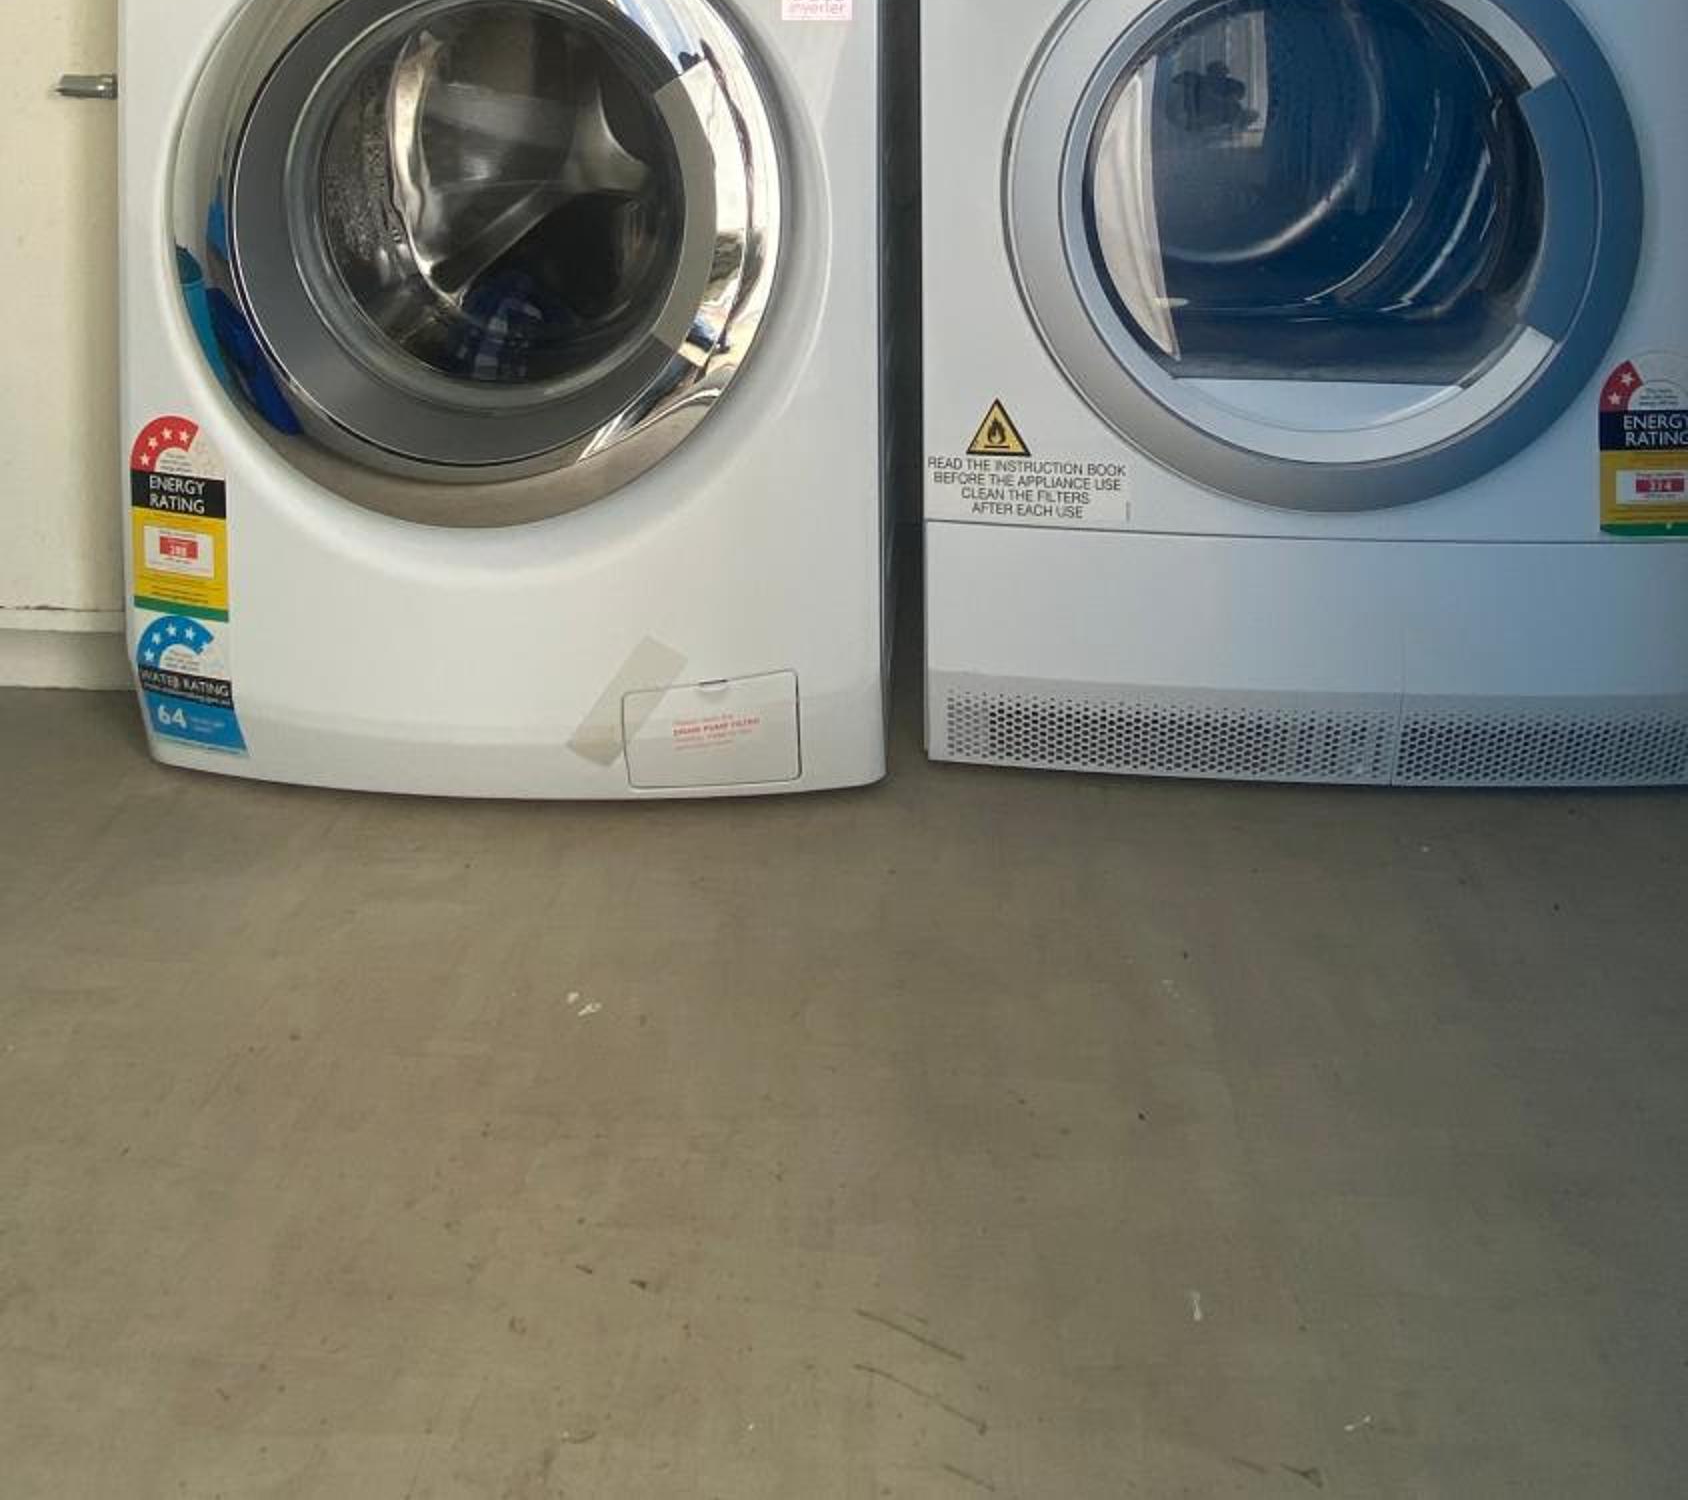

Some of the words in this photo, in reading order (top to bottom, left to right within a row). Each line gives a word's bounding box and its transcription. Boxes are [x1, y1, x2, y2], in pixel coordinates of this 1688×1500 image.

[1625, 431, 1688, 447] RATING
[927, 456, 963, 470] READ
[967, 457, 991, 472] THE
[995, 459, 1083, 475] INSTRUCTION
[1087, 462, 1127, 477] BOOK
[149, 475, 205, 495] ENERGY
[934, 471, 985, 486] BEFORE
[990, 473, 1014, 487] THE
[1017, 475, 1091, 490] APPLIANCE
[1095, 477, 1121, 491] USE
[149, 494, 206, 515] RATING
[961, 487, 1004, 501] CLEAN
[1008, 488, 1033, 502] THE
[1037, 490, 1090, 505] FILTERS
[971, 502, 1013, 516] AFTER
[1017, 504, 1053, 518] EACH
[1057, 505, 1083, 519] USE
[157, 704, 188, 729] 64
